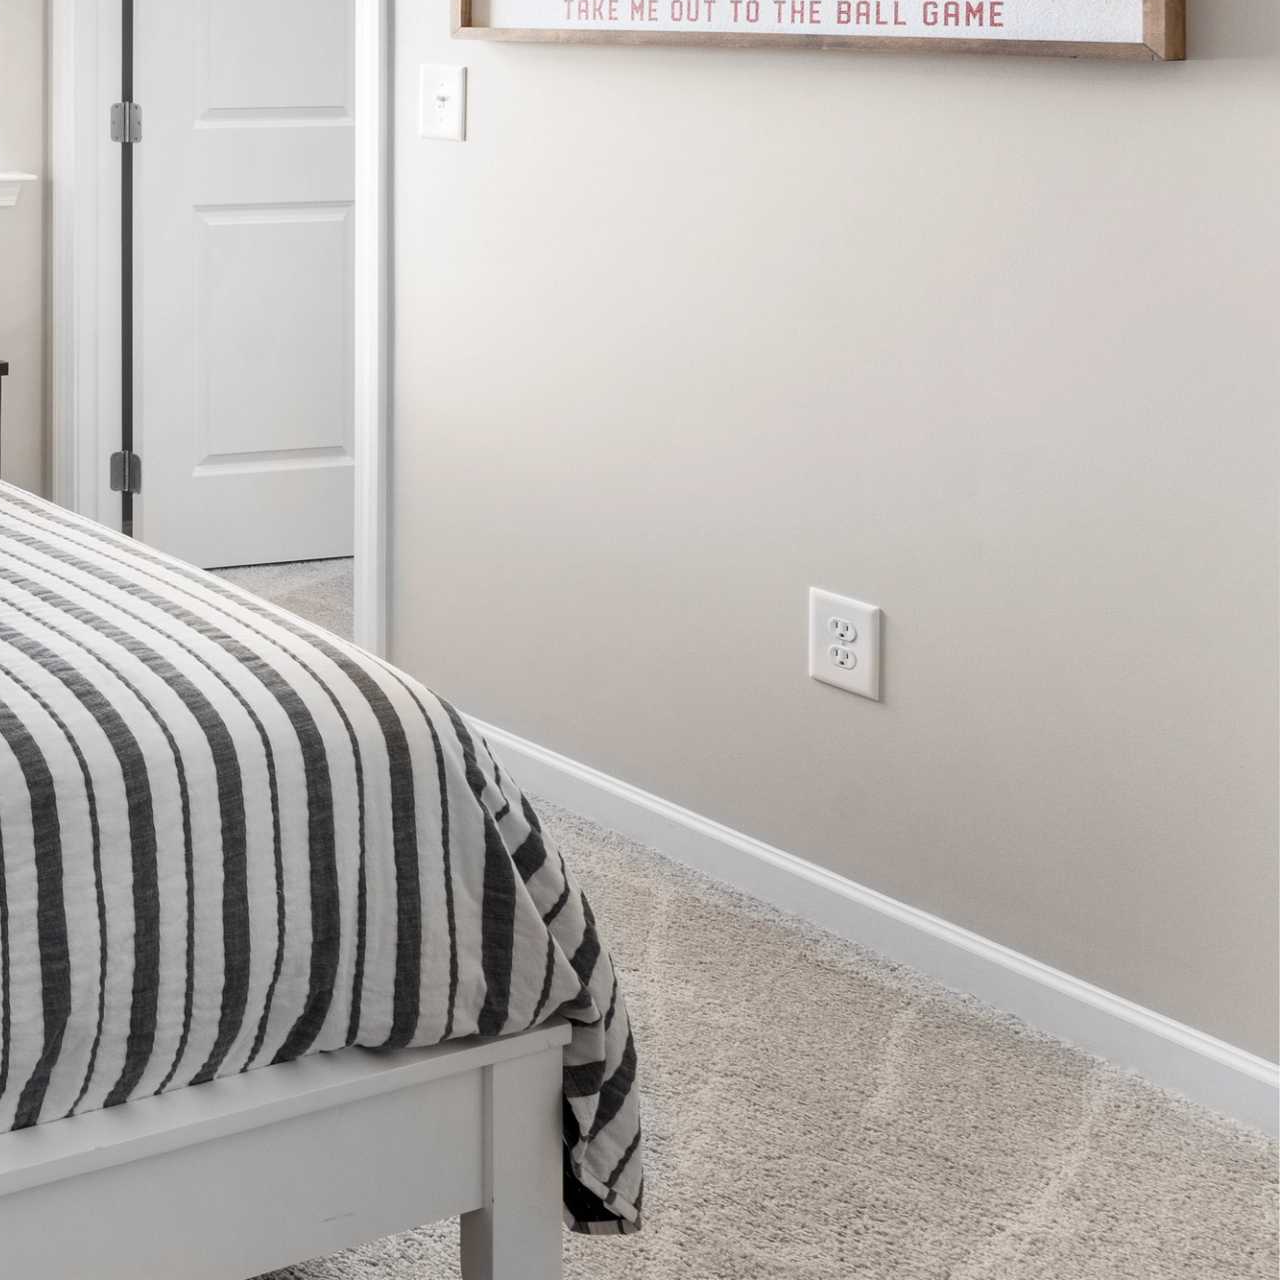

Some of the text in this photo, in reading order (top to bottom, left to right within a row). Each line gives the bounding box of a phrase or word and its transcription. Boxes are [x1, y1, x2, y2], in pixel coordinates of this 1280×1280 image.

[563, 0, 1005, 27] TAKE ME OUT TO THE BALL GAME
